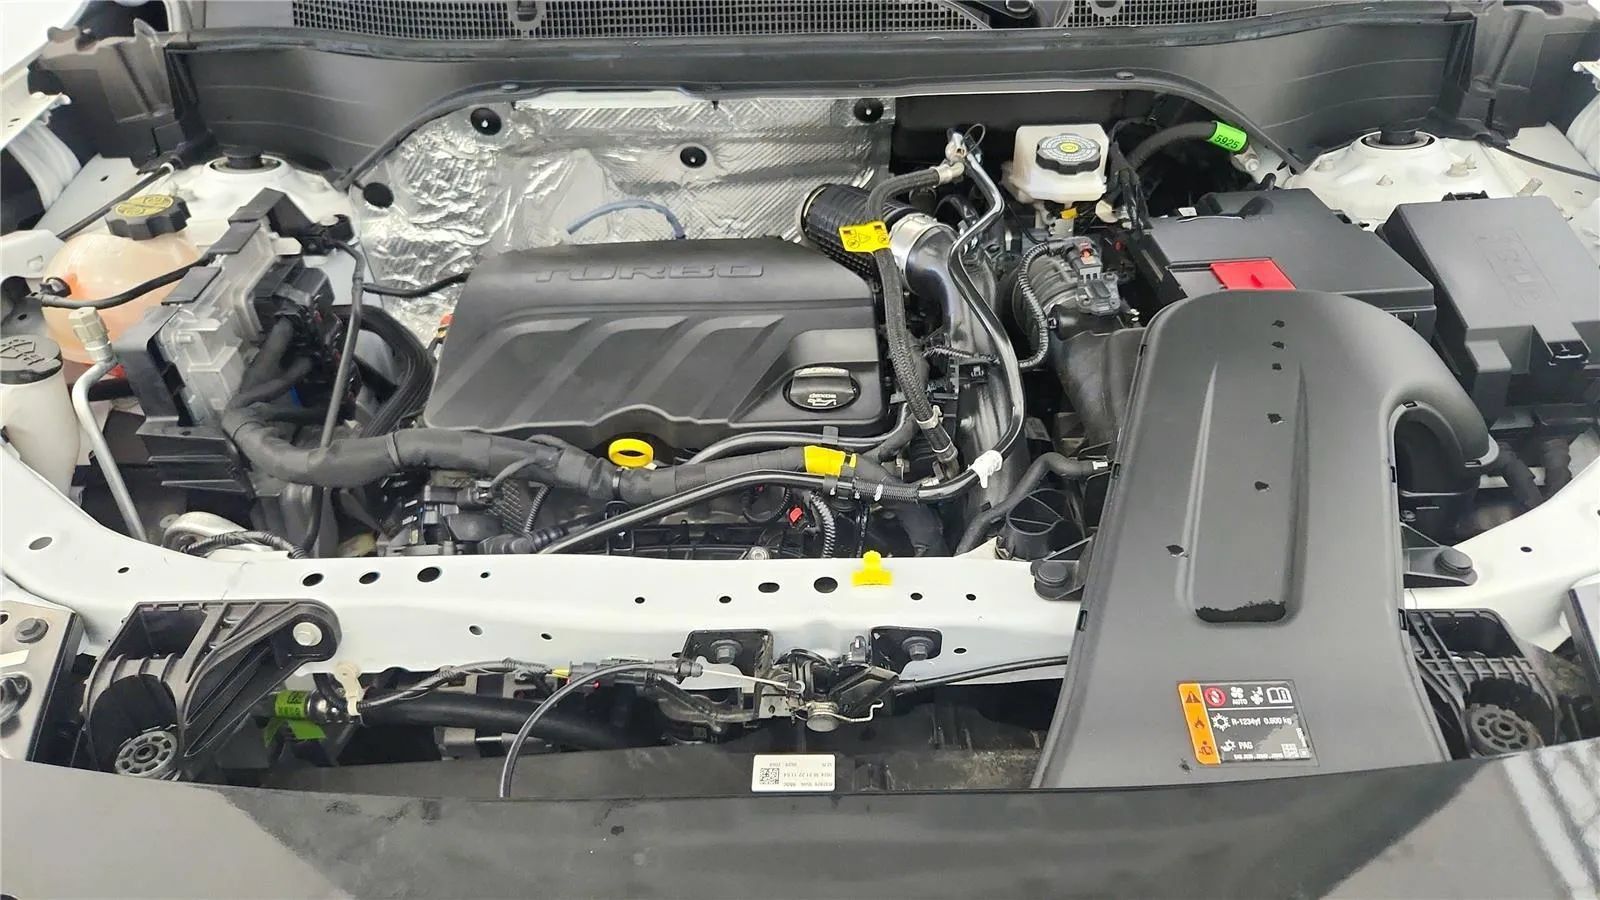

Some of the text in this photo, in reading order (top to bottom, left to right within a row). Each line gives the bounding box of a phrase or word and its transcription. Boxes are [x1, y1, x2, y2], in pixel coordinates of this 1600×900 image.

[1214, 134, 1240, 149] 5925
[533, 263, 764, 283] TURBO
[1238, 741, 1254, 750] PAG
